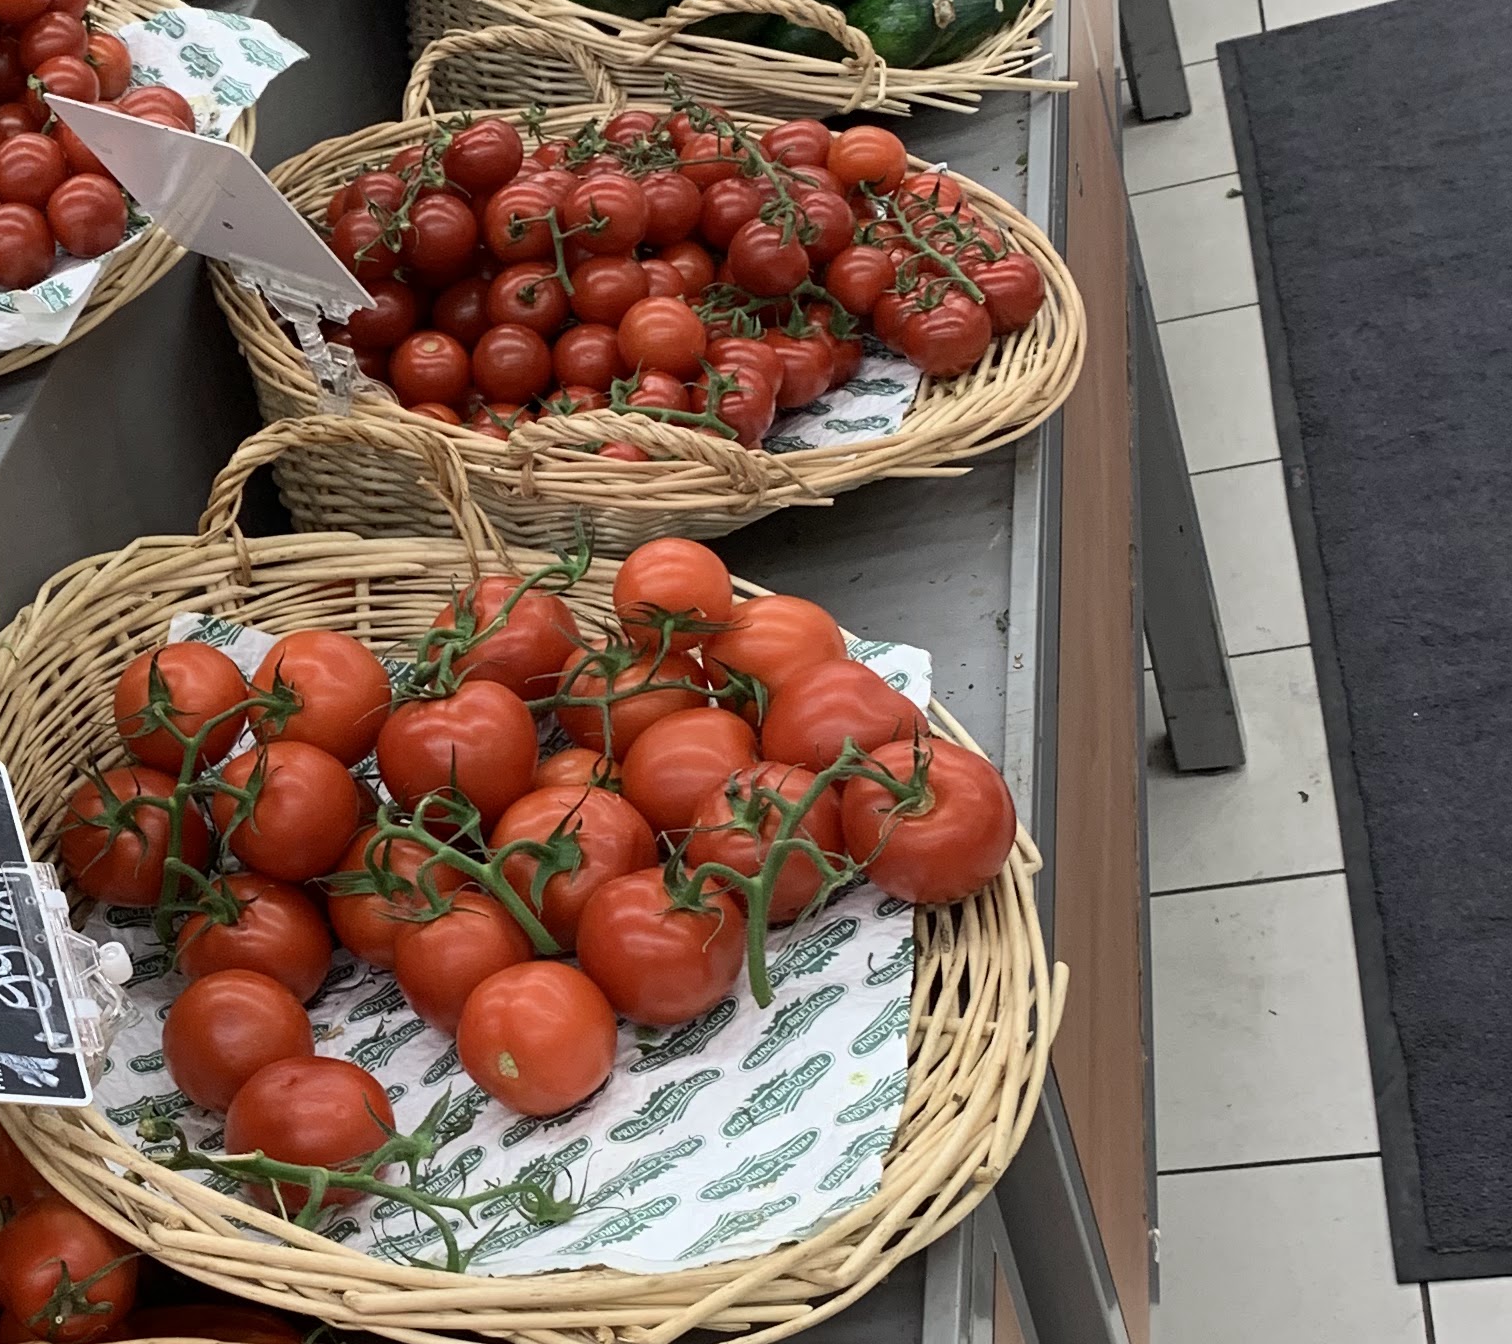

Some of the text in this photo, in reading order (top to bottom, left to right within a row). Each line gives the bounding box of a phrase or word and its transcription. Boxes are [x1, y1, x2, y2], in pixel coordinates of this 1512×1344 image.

[819, 920, 855, 951] PRINCE
[634, 1045, 674, 1072] PRINCE
[684, 1001, 735, 1047] BRETAGNE
[746, 1032, 782, 1068] PRINCE
[787, 985, 840, 1027] BRETAGNE
[614, 1069, 718, 1143] PRINCE de BRETAGNE
[764, 1096, 777, 1112] de
[774, 1055, 828, 1103] BRETAGNE
[705, 1132, 815, 1199] PRINCE de BRETAGNE
